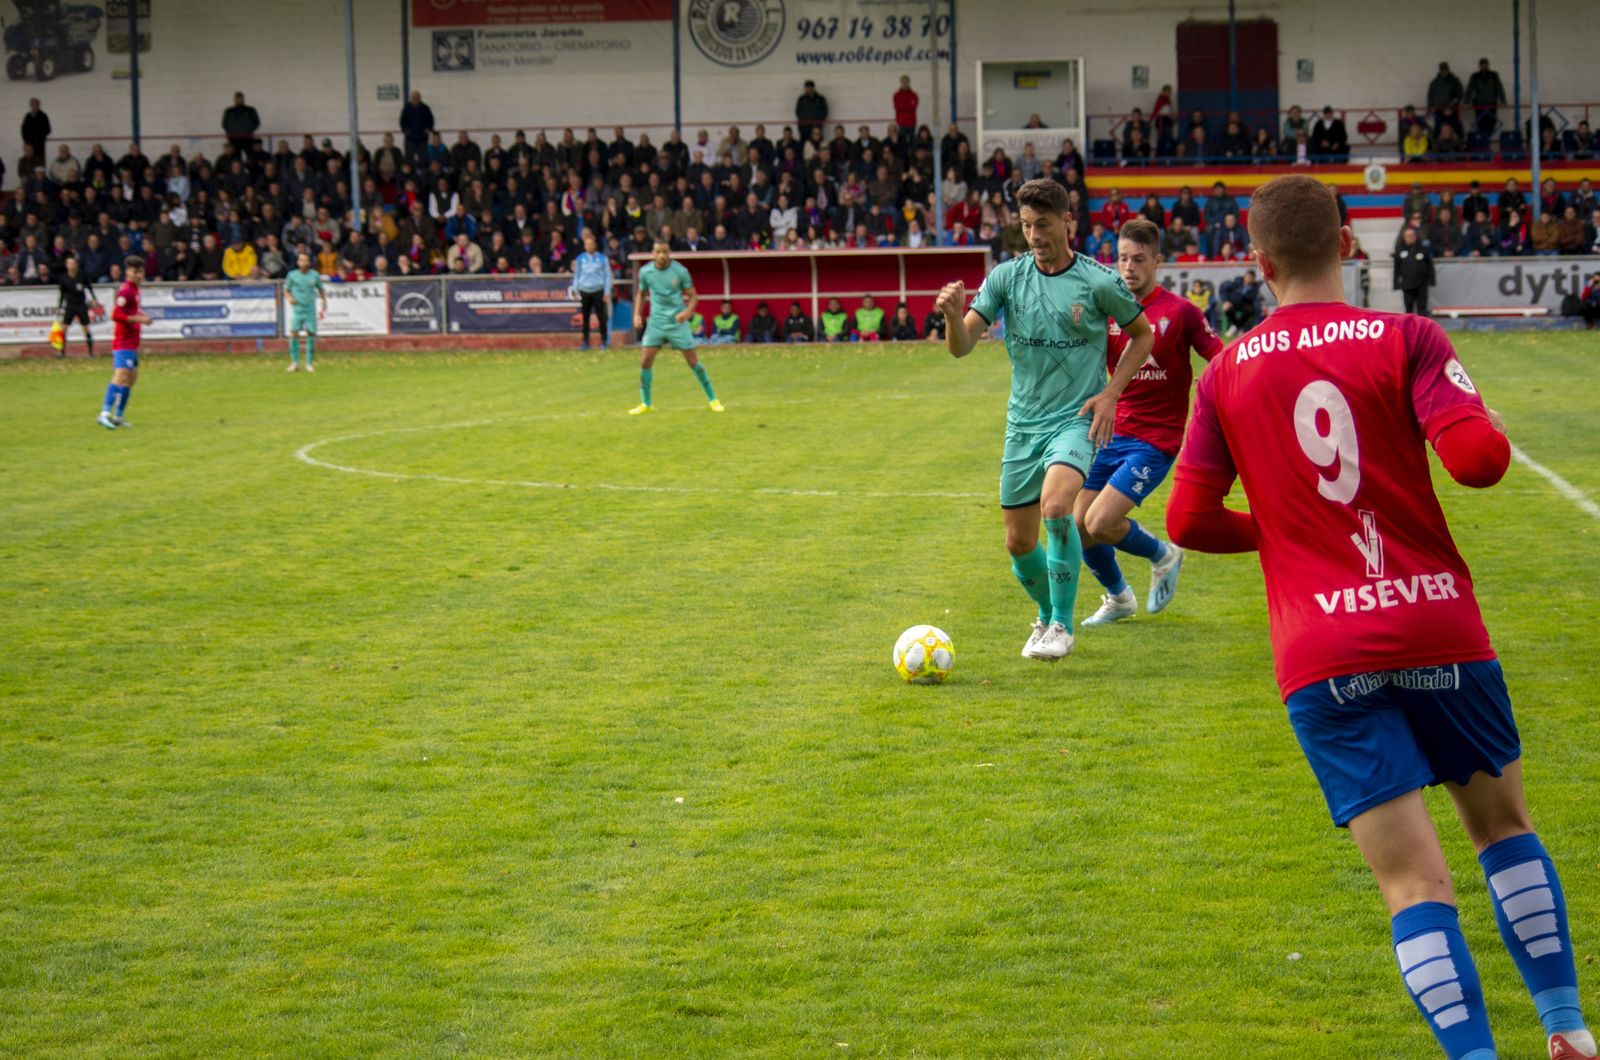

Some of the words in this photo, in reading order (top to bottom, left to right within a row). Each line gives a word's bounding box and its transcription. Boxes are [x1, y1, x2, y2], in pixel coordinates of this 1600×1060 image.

[477, 29, 536, 39] Funeraria
[797, 17, 840, 41] 967
[848, 16, 873, 39] 14
[883, 15, 912, 39] 38
[920, 14, 951, 38] 70
[478, 41, 541, 51] TANATORIO
[554, 39, 631, 50] CREMATORIO
[1498, 264, 1582, 304] dyti
[319, 289, 358, 301] esel,
[1012, 334, 1088, 350] master.house
[1236, 331, 1290, 364] AGUS
[1296, 319, 1385, 349] ALONSO
[1132, 369, 1168, 381] ITANK
[1293, 380, 1361, 505] 9
[1314, 572, 1460, 614] VISEVER
